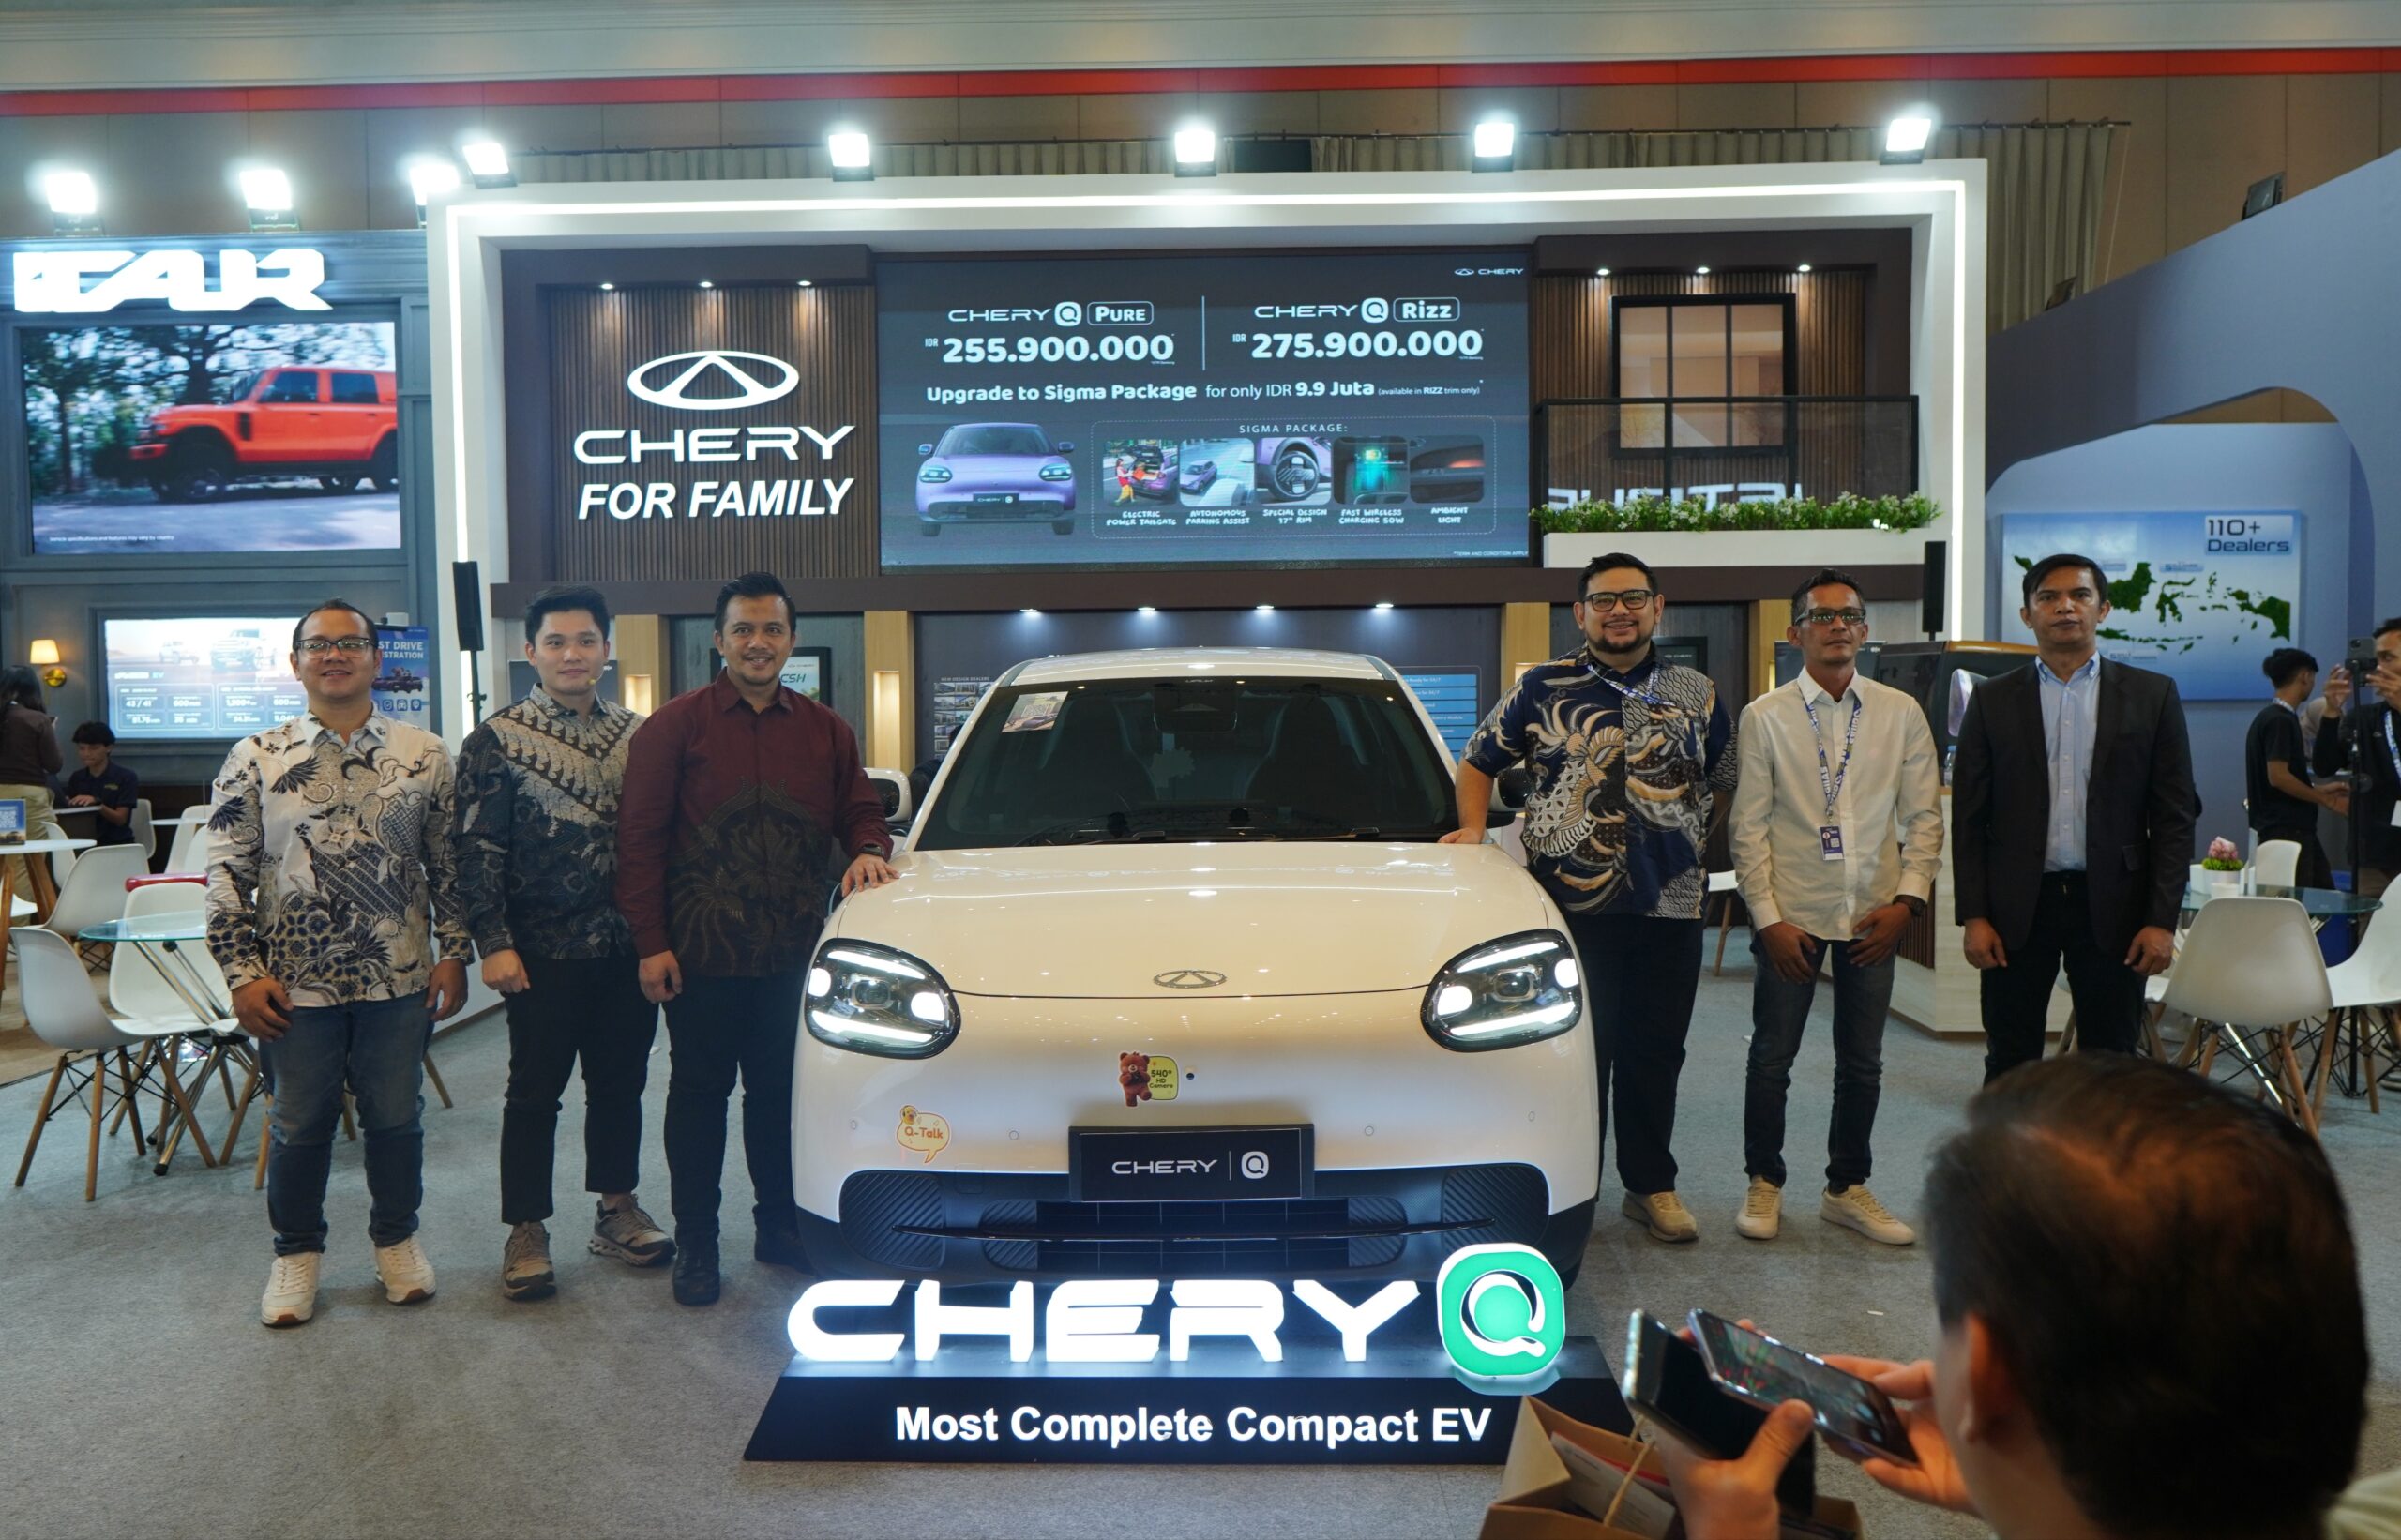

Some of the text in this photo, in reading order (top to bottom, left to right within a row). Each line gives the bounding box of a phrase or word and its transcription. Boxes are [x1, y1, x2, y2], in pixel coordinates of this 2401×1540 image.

[948, 309, 1051, 322] CHERY
[1254, 305, 1358, 318] CHERY
[1402, 300, 1452, 319] Rizz
[925, 338, 938, 347] IDR
[1232, 333, 1246, 343] IDR
[927, 386, 1013, 405] Upgrade
[1018, 386, 1039, 400] to
[1045, 384, 1106, 403] Sigma
[1111, 384, 1197, 402] Package
[1206, 385, 1227, 397] for
[1230, 385, 1262, 400] only
[1266, 384, 1292, 397] IDR
[1295, 381, 1325, 396] 9.9
[1330, 381, 1374, 396] Juta
[1378, 386, 1412, 396] (available
[1239, 423, 1348, 433] SIGMA PACKAGE:
[574, 425, 856, 464] CHERY
[578, 478, 855, 520] FOR FAMILY
[1189, 509, 1246, 517] AUTONOMOUS
[1341, 508, 1402, 517] FAST WIRELESS
[1106, 517, 1177, 526] POWER TAILGATE
[1339, 516, 1381, 525] CHARGING
[2208, 519, 2261, 536] 110+
[2208, 538, 2289, 552] Dealers
[378, 641, 423, 650] ST DRIVE
[781, 674, 806, 683] CSH
[905, 1126, 943, 1139] Q-Talk
[1112, 1159, 1218, 1175] CHERY
[786, 1279, 1421, 1363] CHERY
[895, 1406, 1492, 1449] Most Complete Compact EV
